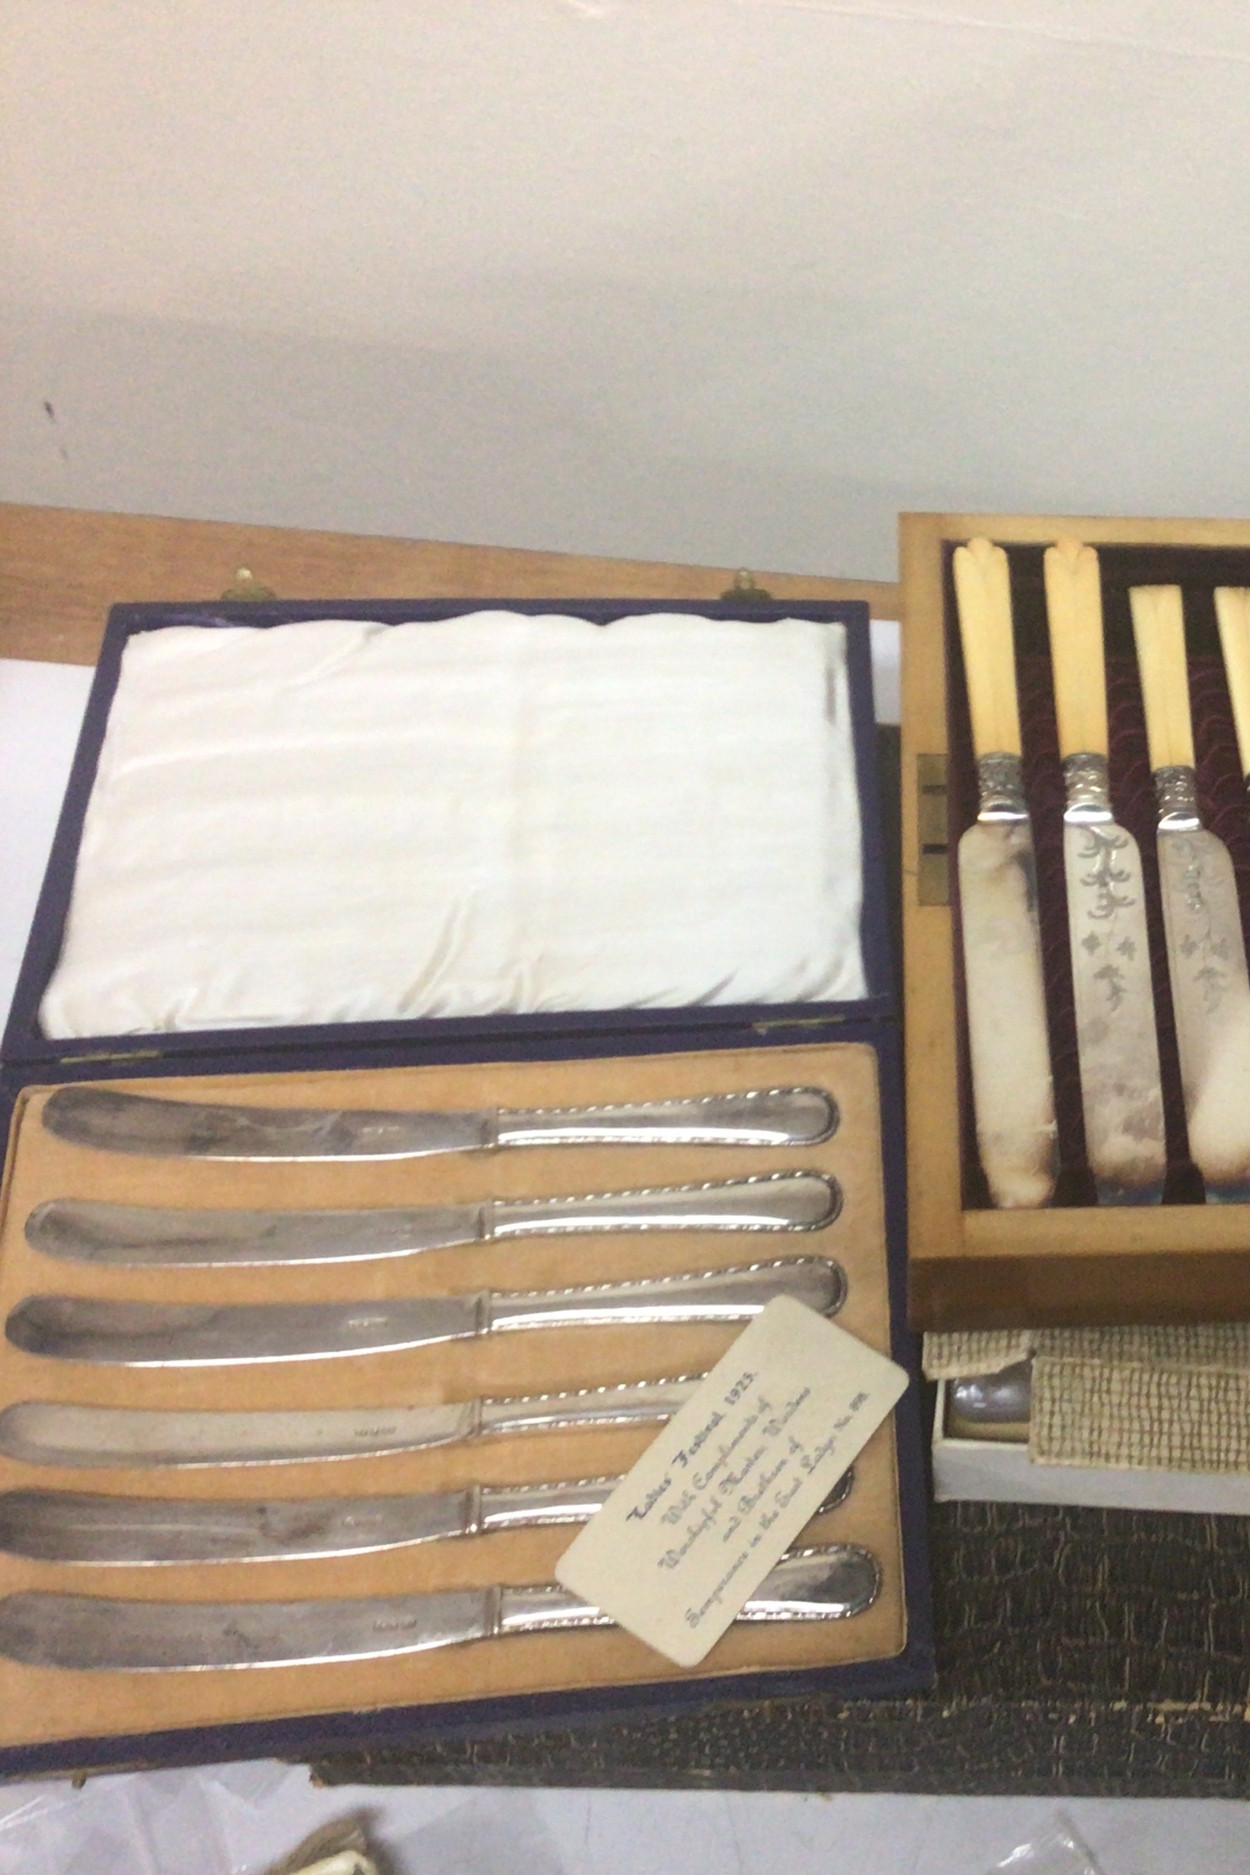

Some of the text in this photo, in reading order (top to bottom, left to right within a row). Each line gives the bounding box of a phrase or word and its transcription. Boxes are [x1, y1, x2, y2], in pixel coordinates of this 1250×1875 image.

[660, 1489, 696, 1525] With
[757, 1395, 772, 1414] of
[722, 1515, 741, 1543] and
[788, 1435, 803, 1454] of
[749, 1534, 762, 1547] in
[758, 1509, 779, 1530] the
